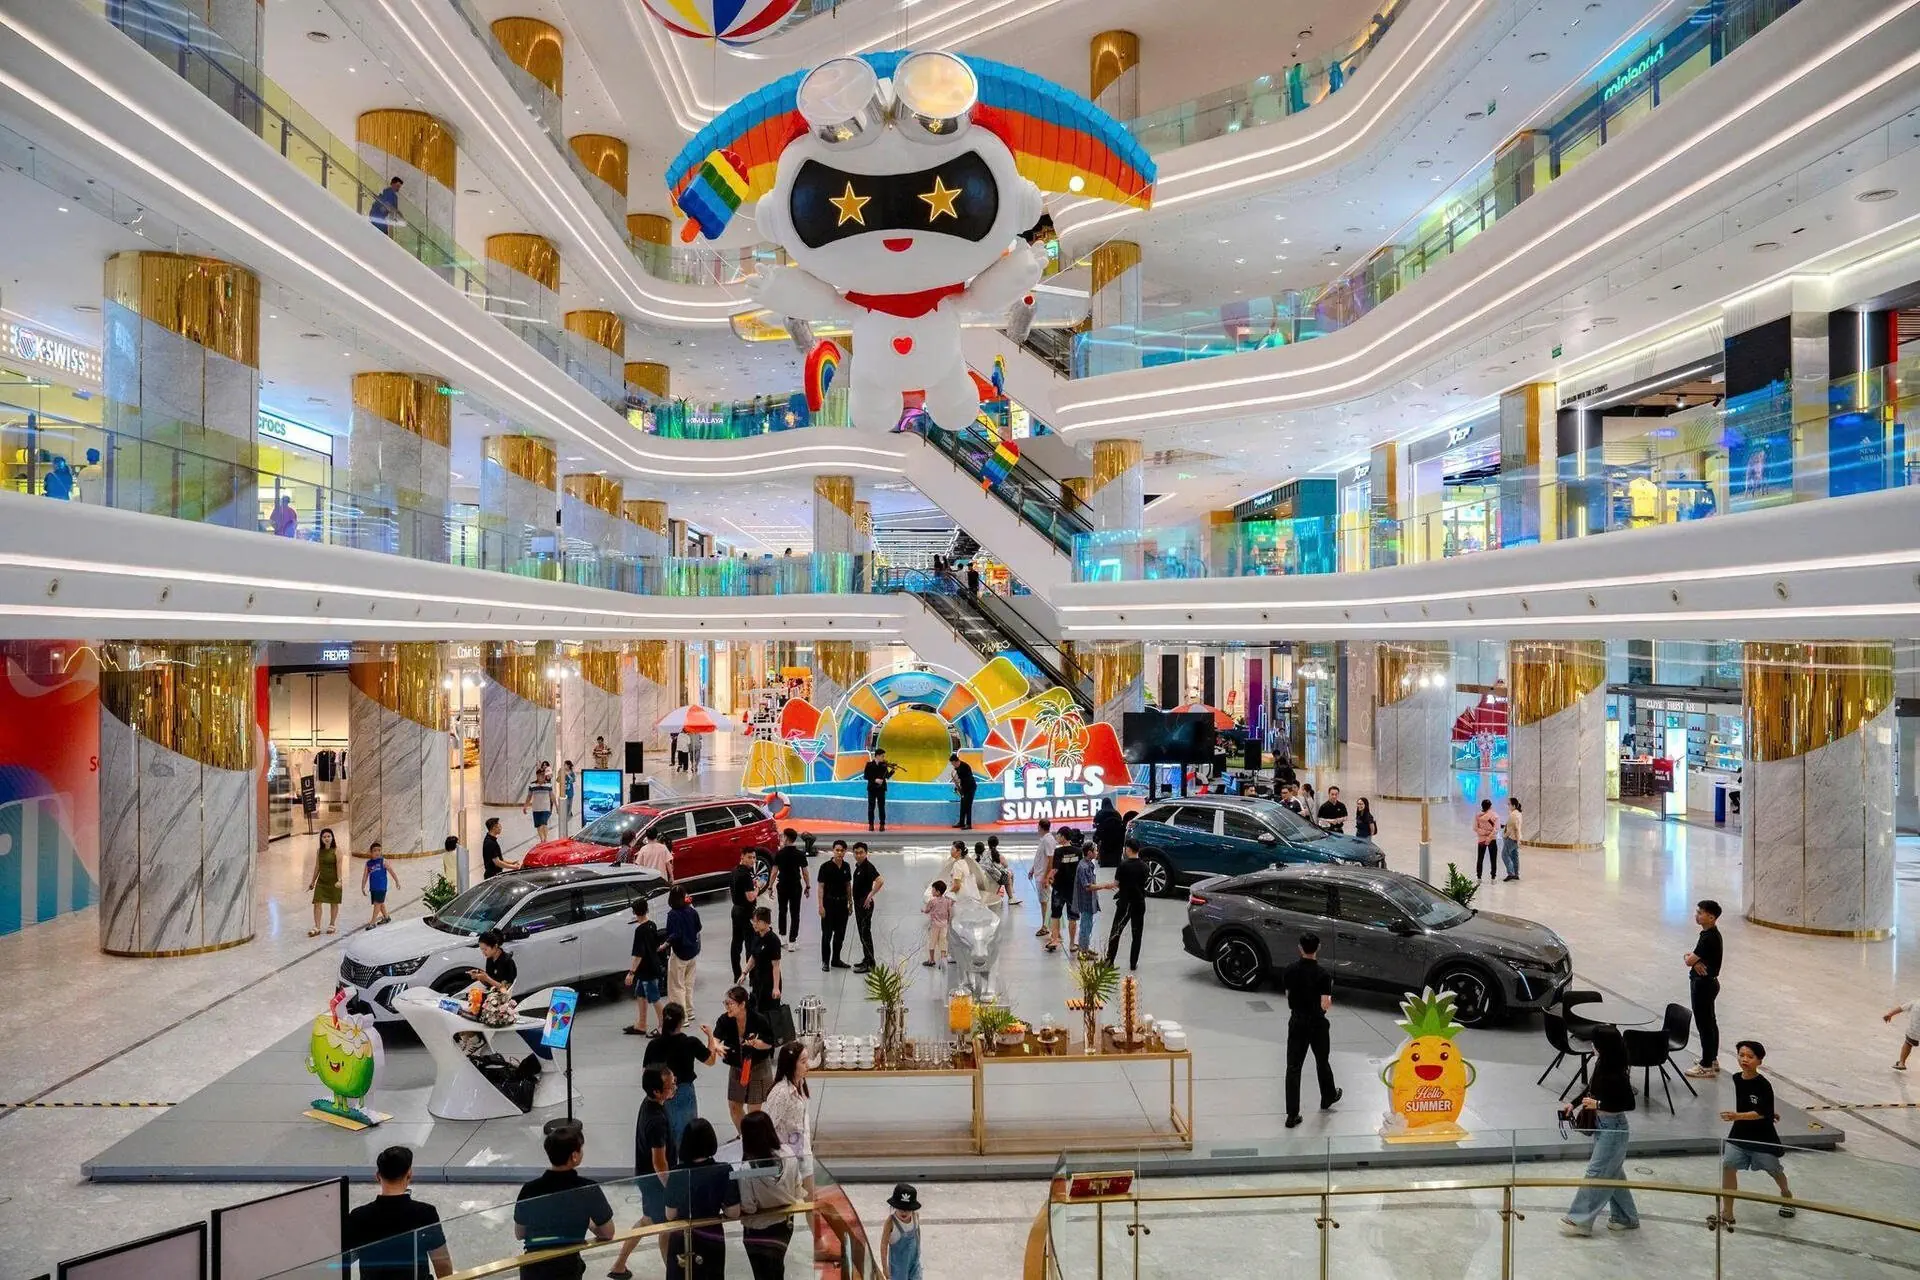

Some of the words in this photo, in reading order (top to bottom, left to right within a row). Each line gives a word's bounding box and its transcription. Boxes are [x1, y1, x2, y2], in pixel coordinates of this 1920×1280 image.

[1004, 764, 1105, 800] LET'S
[1003, 799, 1103, 821] SUMMER
[1414, 1086, 1443, 1100] Hello
[1405, 1100, 1452, 1112] SUMMER
